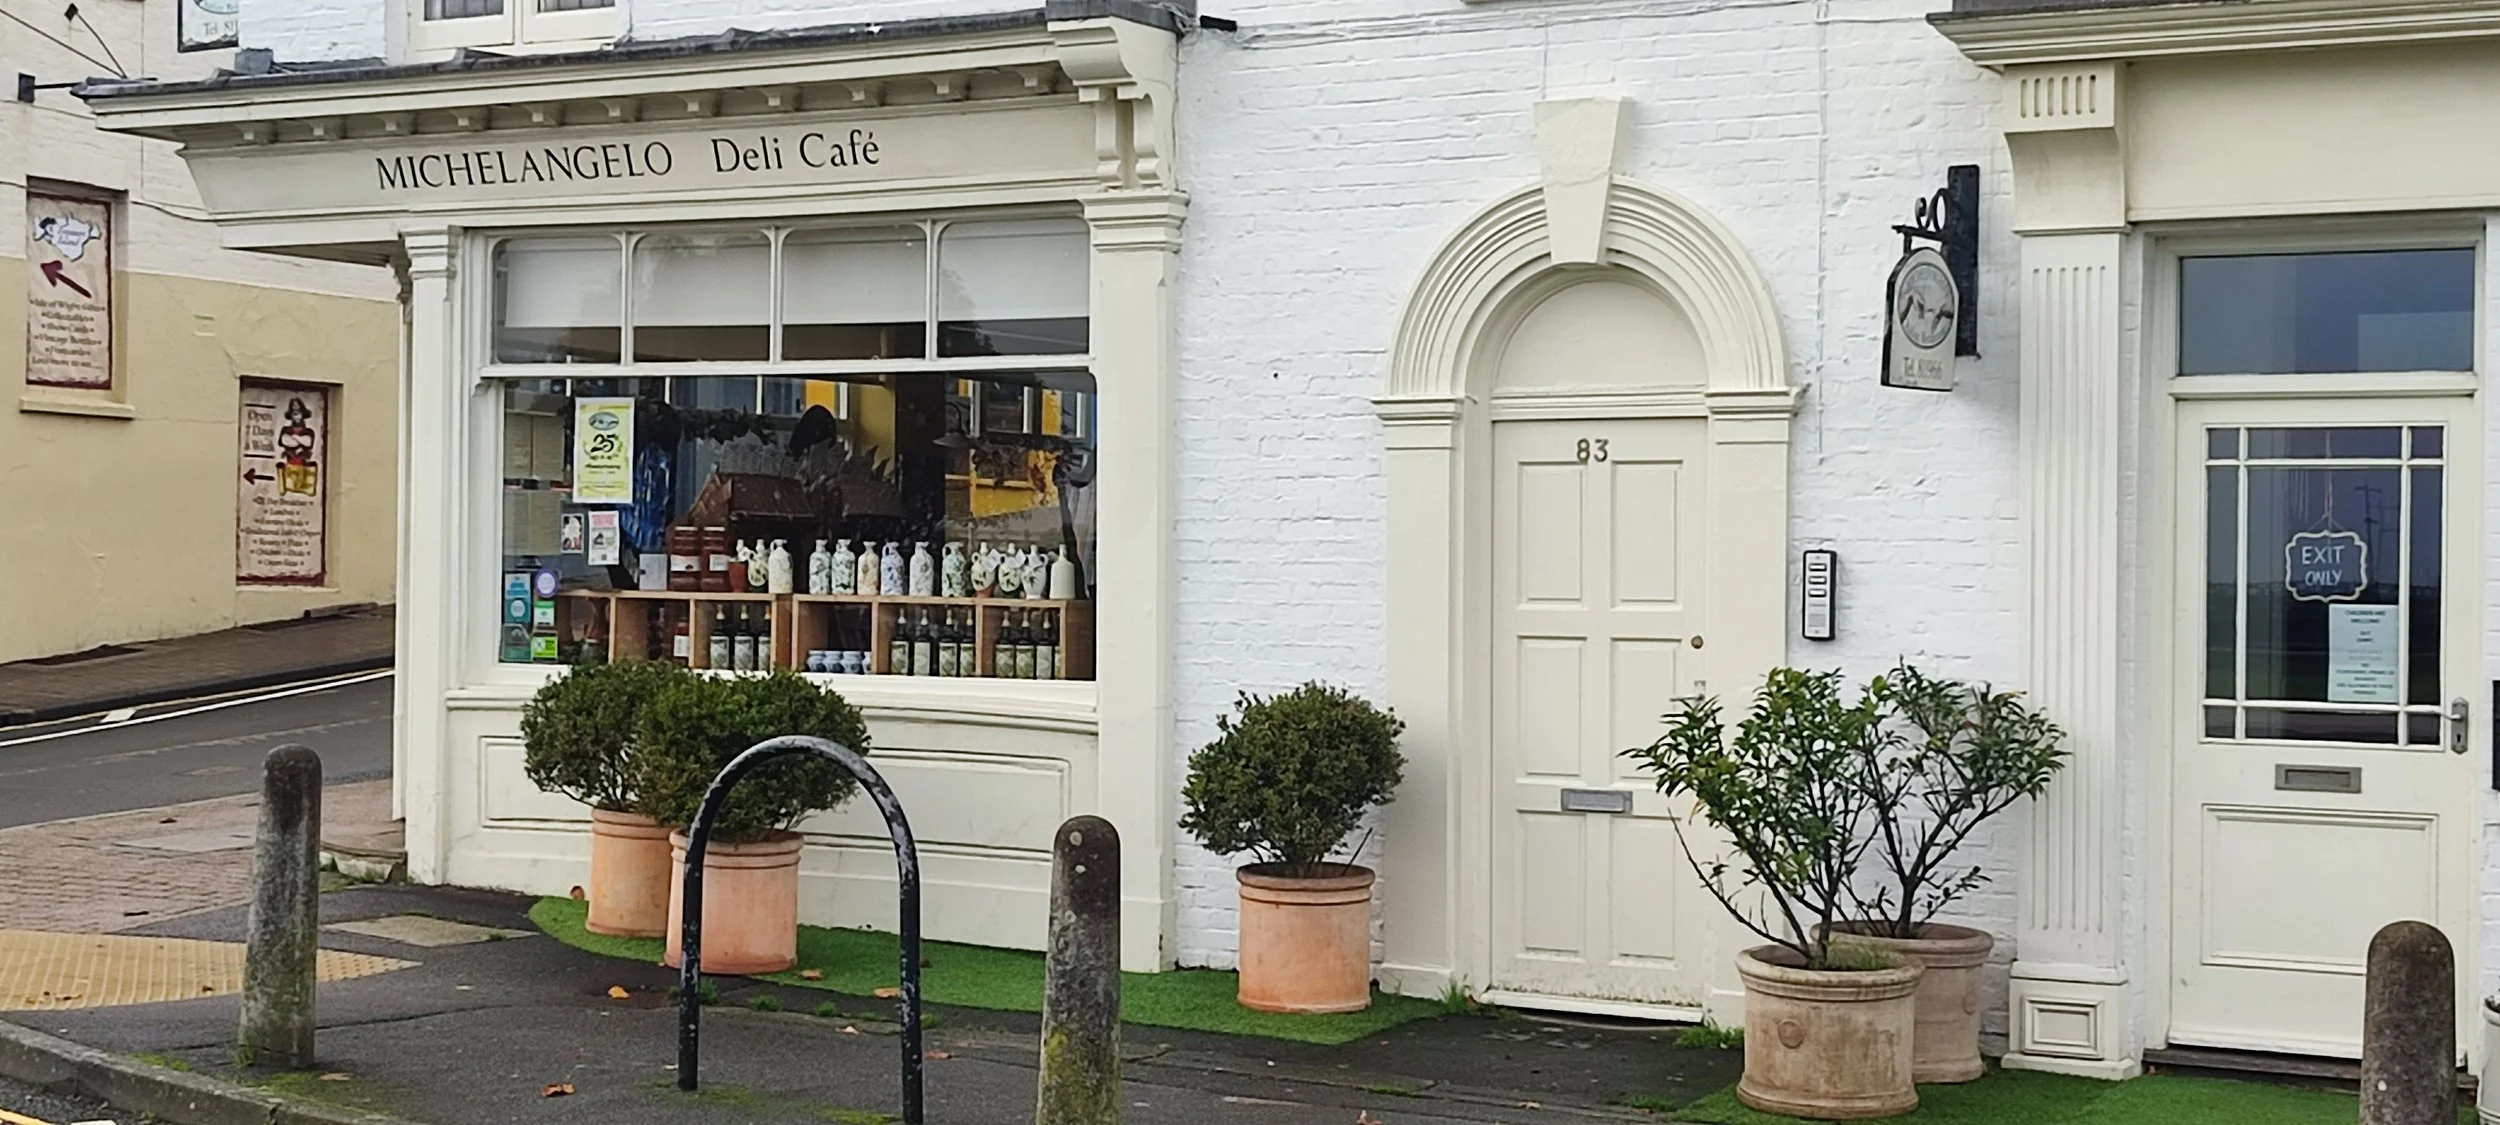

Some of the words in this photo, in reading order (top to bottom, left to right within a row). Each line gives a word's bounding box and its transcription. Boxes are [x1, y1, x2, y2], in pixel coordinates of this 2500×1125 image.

[376, 141, 673, 190] MICHELANGELO
[711, 136, 784, 172] Deli
[799, 129, 880, 168] Café
[1576, 437, 1610, 464] 83
[2301, 544, 2346, 566] EXIT
[2304, 568, 2343, 587] ONLY
